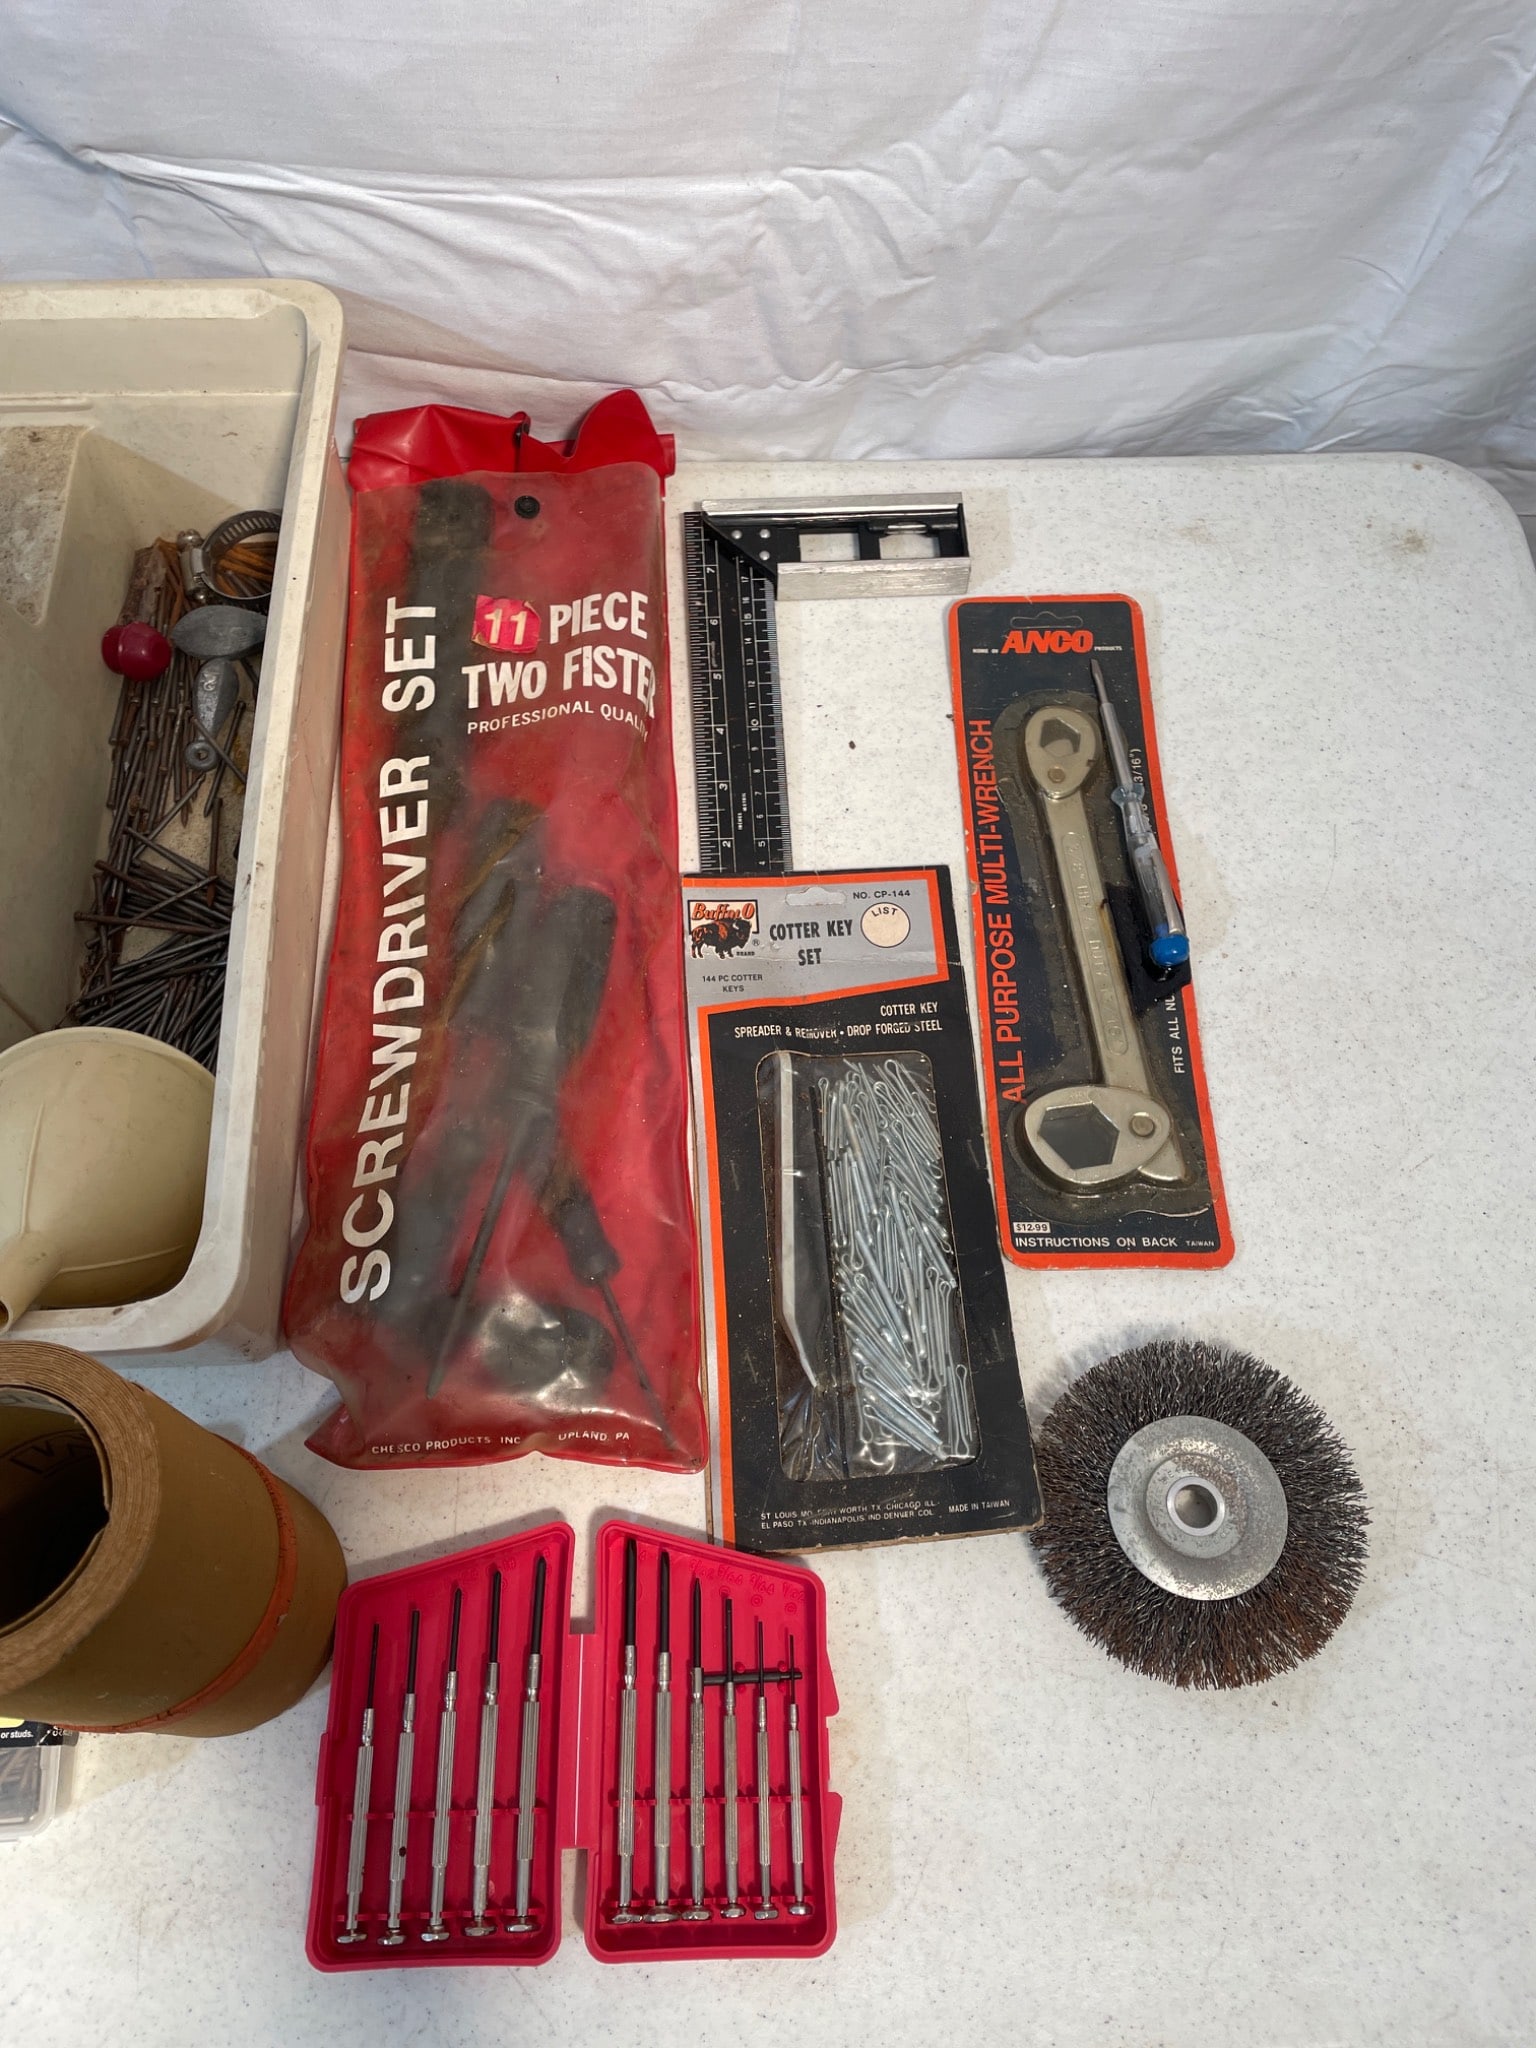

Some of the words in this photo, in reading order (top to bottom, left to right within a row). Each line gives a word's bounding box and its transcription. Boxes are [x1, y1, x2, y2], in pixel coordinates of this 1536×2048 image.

[484, 608, 529, 647] 11
[549, 590, 648, 644] PIECE
[1000, 630, 1094, 654] ANCO
[381, 597, 437, 712] SET
[461, 660, 547, 709] TWO
[467, 700, 594, 735] PROFESSIONAL
[719, 783, 728, 791] 3
[968, 719, 1010, 903] MULTI-WRENCH
[758, 840, 766, 848] 5
[852, 891, 871, 900] NO.
[874, 889, 911, 899] CP-144
[871, 906, 898, 918] LIST
[769, 921, 820, 941] COTTER
[826, 919, 853, 937] KEY
[798, 948, 822, 966] SET
[731, 974, 763, 982] COTTER
[988, 912, 1021, 1042] PURPOSE
[722, 985, 745, 993] KEYS
[880, 1003, 918, 1017] COTTER
[920, 1001, 938, 1014] KEY
[339, 755, 430, 1304] SCREWDRIVER
[734, 1024, 782, 1039] SPREADER
[785, 1026, 792, 1037] &
[846, 1024, 872, 1037] DROP
[875, 1022, 911, 1035] FORGED
[914, 1019, 943, 1033] STEEL
[1168, 1017, 1180, 1040] ALL
[1171, 1046, 1185, 1074] FITS
[1000, 1050, 1027, 1104] ALL
[1015, 1237, 1110, 1248] INSTRUCTIONS
[1116, 1237, 1136, 1247] ON
[1143, 1237, 1178, 1247] BACK
[558, 1430, 608, 1441] UPLAND
[615, 1432, 630, 1441] PA
[371, 1442, 421, 1454] CHESCO
[425, 1436, 492, 1451] PRODUCTS
[500, 1436, 521, 1445] INC
[760, 1511, 770, 1521] ST
[774, 1511, 798, 1520] LOUIS
[839, 1505, 868, 1514] WORTH
[948, 1503, 969, 1513] MADE
[971, 1502, 979, 1510] IN
[981, 1499, 1010, 1509] TAIWAN
[761, 1522, 771, 1530] EL
[773, 1520, 794, 1529] PASO
[10, 1730, 34, 1738] studs.
